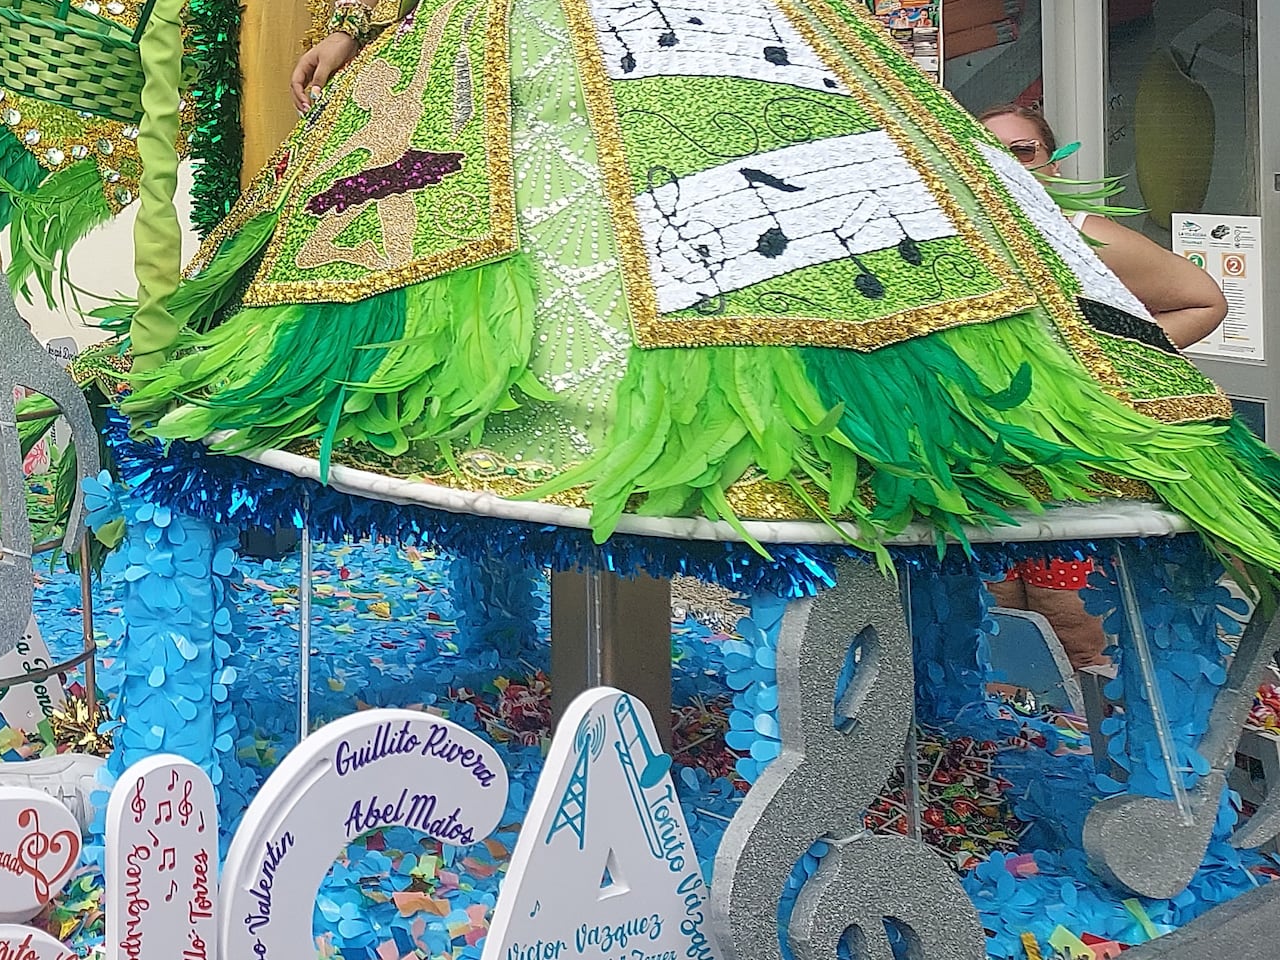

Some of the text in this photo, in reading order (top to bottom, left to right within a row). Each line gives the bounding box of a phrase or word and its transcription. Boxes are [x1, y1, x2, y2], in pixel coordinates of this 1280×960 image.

[336, 721, 496, 787] Guillito Rivera
[345, 788, 474, 845] Abel Matos
[651, 784, 686, 873] Toñito
[188, 848, 213, 924] Torres
[244, 831, 295, 935] Valentin
